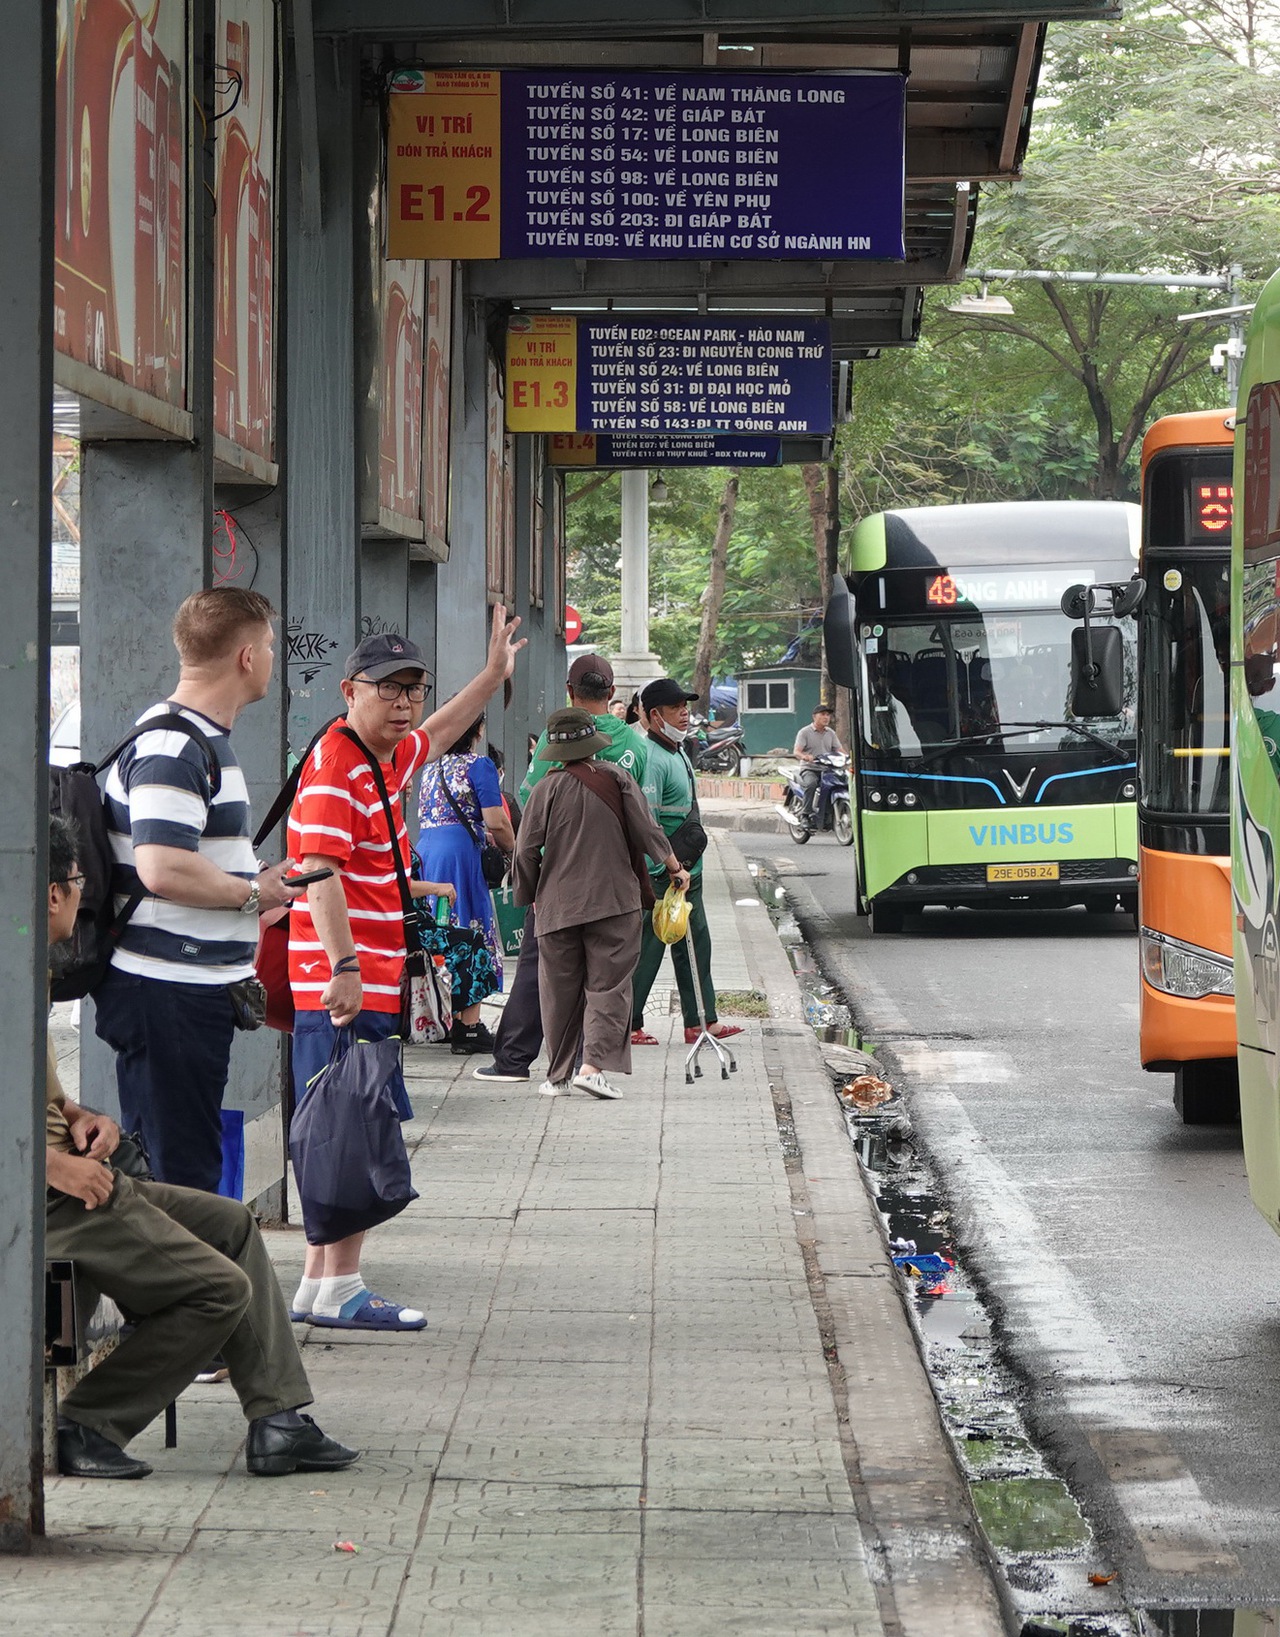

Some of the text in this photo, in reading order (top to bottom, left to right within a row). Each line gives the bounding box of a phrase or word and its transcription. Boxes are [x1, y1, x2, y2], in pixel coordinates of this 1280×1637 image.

[527, 82, 844, 103] TUYẾN SỐ 41: VỀ NAM THĂNG LONG
[527, 103, 765, 123] TUYẾN SỐ 42: VỀ GIÁP BÁT
[416, 112, 472, 137] VỊ TRÍ
[527, 123, 778, 142] TUYẾN SỐ 17: VỀ LONG BIÊN
[397, 141, 492, 158] ĐÓN TRẢ KHÁCH
[527, 143, 778, 163] TUYẾN SỐ 54: VỀ LONG BIÊN
[527, 166, 777, 186] TUYẾN SỐ 98: VỀ LONG BIÊN
[400, 184, 490, 222] E1.2
[527, 188, 770, 210] TUYẾN SỐ 100: VỀ YÊN PHỤ
[527, 209, 772, 228] TUYẾN SỐ 203: ĐI GIÁP BÁT
[527, 228, 578, 245] TUYẾN
[585, 233, 619, 246] E09:
[625, 229, 644, 246] VỀ
[650, 234, 682, 247] KHU
[688, 232, 724, 247] LIÊN
[730, 235, 753, 248] CƠ
[785, 234, 842, 249] NGÀNH
[848, 237, 870, 249] HN
[589, 324, 627, 340] TUYẾN
[660, 329, 700, 341] OCEAN
[704, 330, 736, 342] PARK
[748, 327, 772, 342] HÀO
[776, 330, 804, 342] NAM
[527, 340, 556, 355] VỊ TRÍ
[592, 342, 633, 357] TUYẾN
[638, 342, 655, 357] SỐ
[659, 346, 679, 357] 23:
[683, 346, 695, 357] ĐI
[546, 356, 572, 367] KHÁCH
[592, 360, 634, 376] TUYẾN
[639, 361, 657, 376] SỐ
[662, 365, 682, 376] 24:
[707, 365, 742, 376] LONG
[747, 363, 778, 376] BIÊN
[513, 380, 568, 408] E1.3
[591, 378, 790, 396] TUYẾN SỐ 31: ĐI ĐẠI HỌC MỎ
[591, 397, 636, 412] TUYẾN
[641, 397, 659, 412] SỐ
[664, 401, 686, 412] 58:
[711, 401, 747, 413] LONG
[752, 399, 784, 413] BIÊN
[592, 415, 636, 428] TUYẾN
[641, 416, 659, 428] SỐ
[697, 419, 711, 429] ĐI
[715, 420, 731, 429] TT
[735, 418, 773, 430] ĐÔNG
[778, 421, 807, 431] ANH
[553, 434, 594, 450] E1.4
[928, 575, 957, 604] 43
[1004, 579, 1048, 600] ANH
[969, 823, 1074, 846] VINBUS
